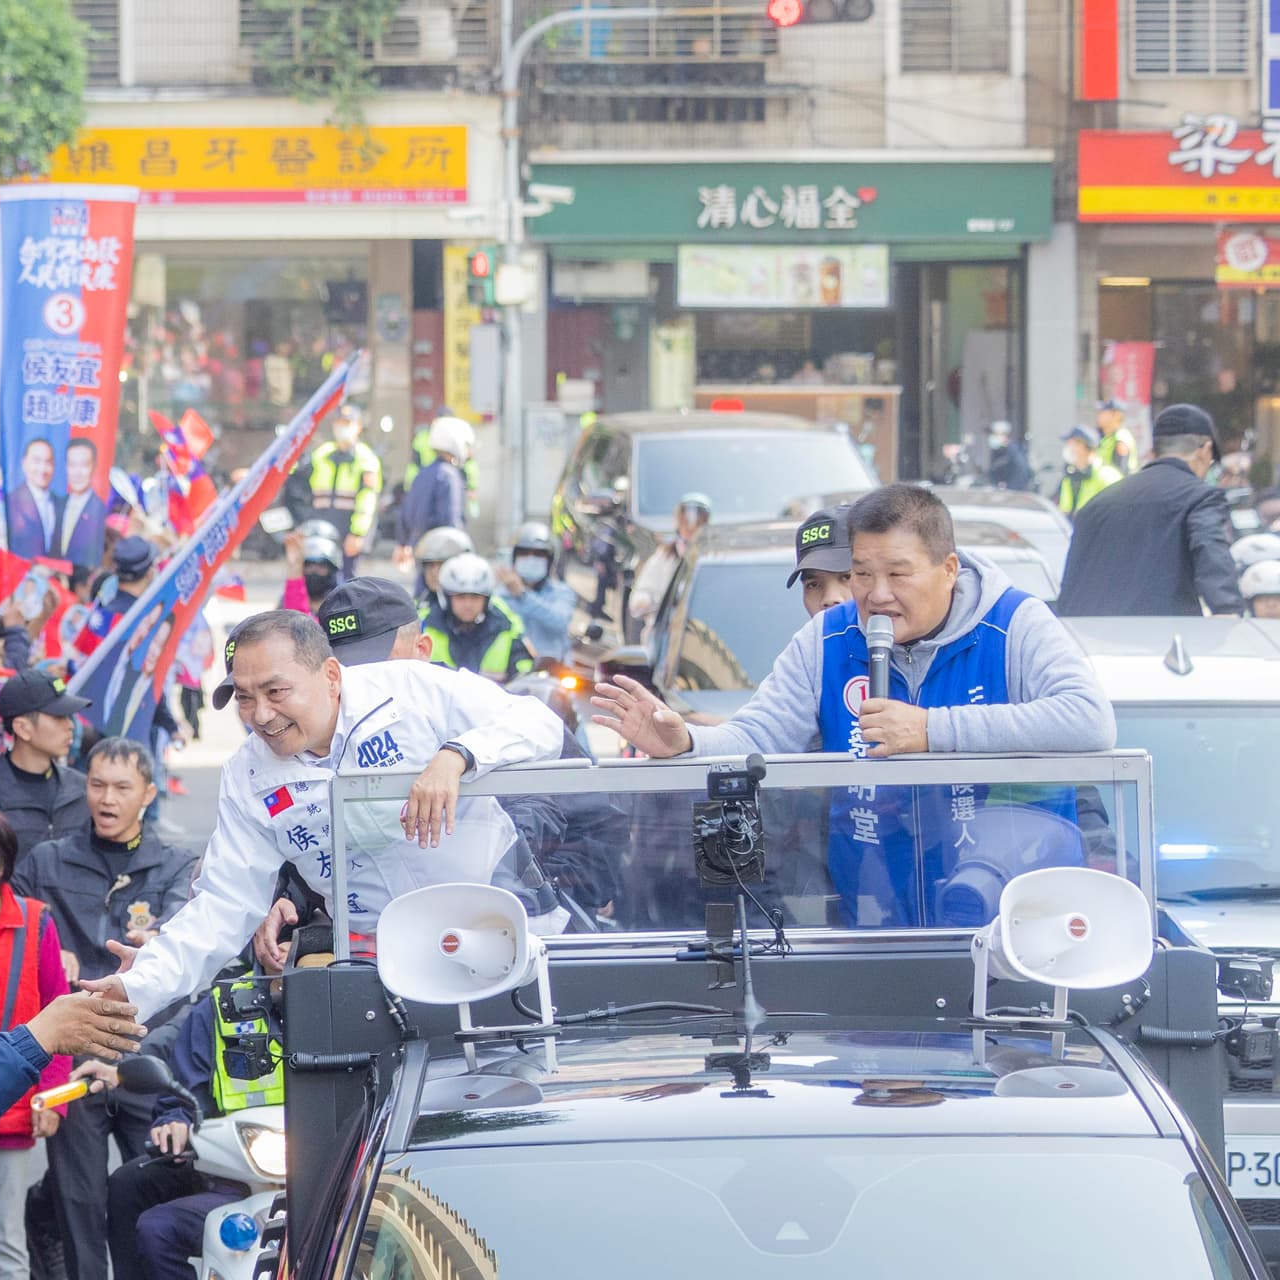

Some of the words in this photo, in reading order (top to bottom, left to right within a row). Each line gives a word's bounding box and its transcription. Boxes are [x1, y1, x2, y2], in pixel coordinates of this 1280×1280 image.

[697, 184, 860, 230] 清心福全
[55, 299, 74, 329] 3
[23, 352, 102, 387] 侯友宜
[801, 525, 830, 545] SSC
[328, 614, 357, 635] SSC
[1227, 1151, 1280, 1188] P-3
